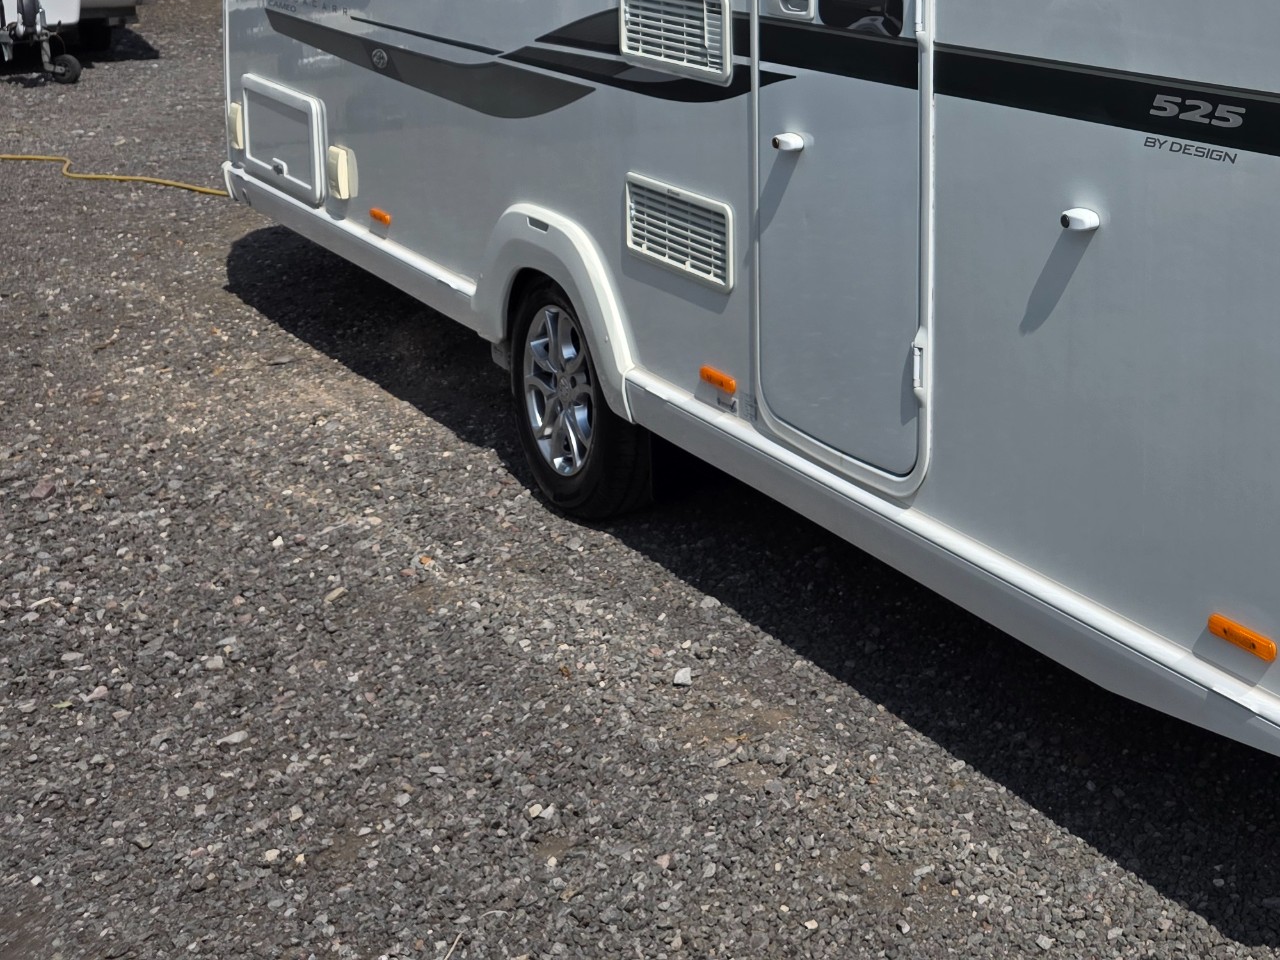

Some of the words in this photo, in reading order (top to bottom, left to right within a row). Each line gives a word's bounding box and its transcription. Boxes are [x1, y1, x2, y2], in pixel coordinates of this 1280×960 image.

[268, 0, 297, 13] CAMEO
[1149, 94, 1246, 128] 525
[1143, 136, 1168, 150] BY
[1168, 142, 1238, 165] DESIGN
